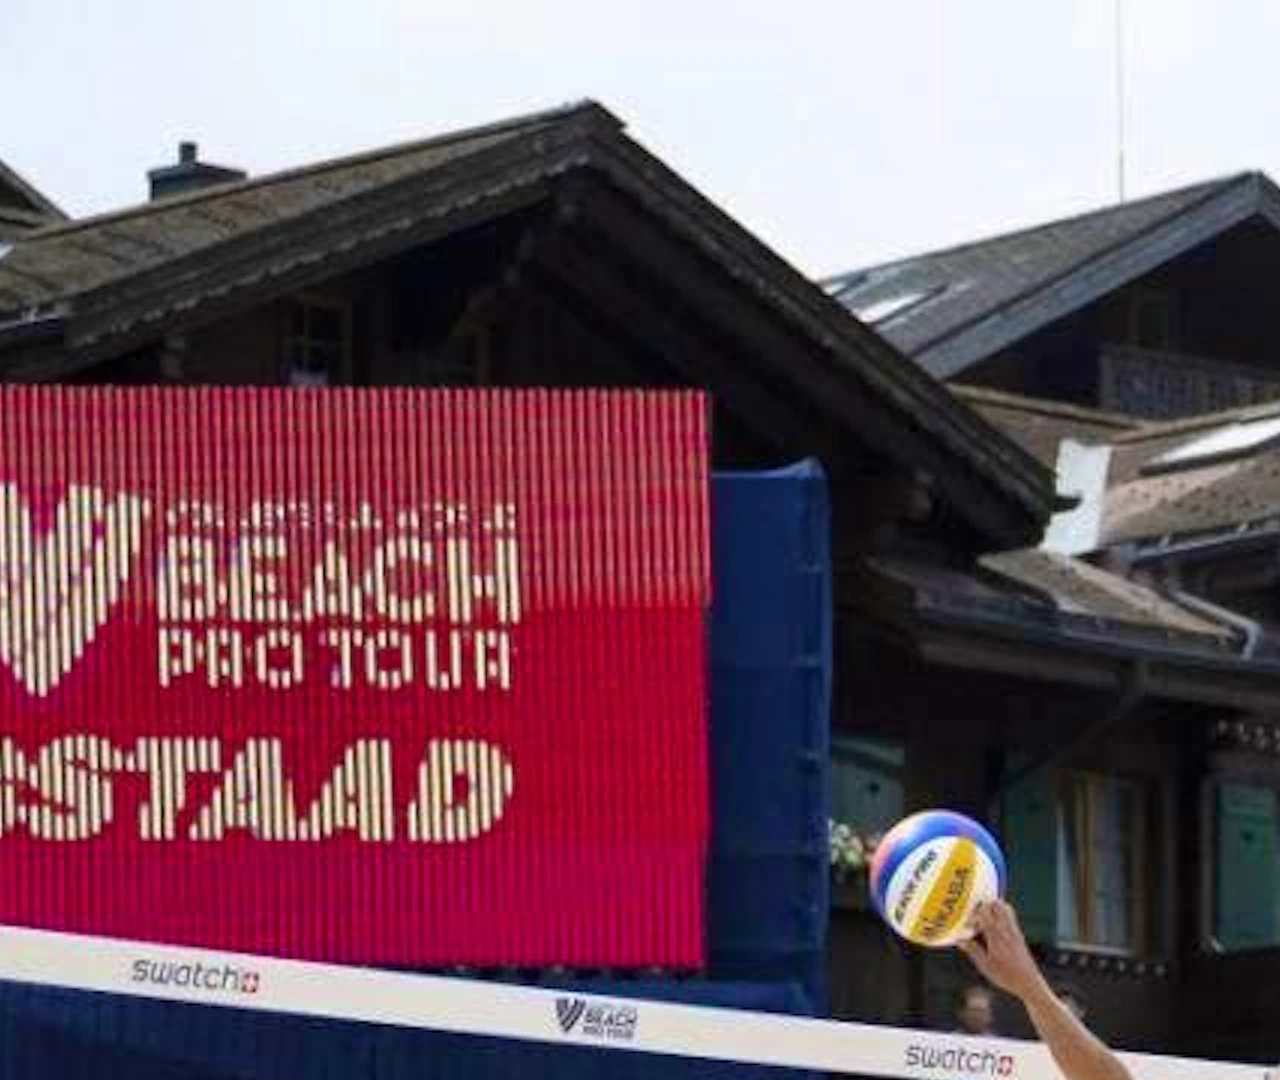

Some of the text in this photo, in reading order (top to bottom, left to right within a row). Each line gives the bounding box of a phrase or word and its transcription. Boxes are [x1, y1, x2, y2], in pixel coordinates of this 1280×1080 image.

[156, 535, 523, 624] BEACH
[158, 630, 514, 690] PRO TOUR
[131, 959, 239, 993] swatch
[905, 1045, 996, 1074] swatch
